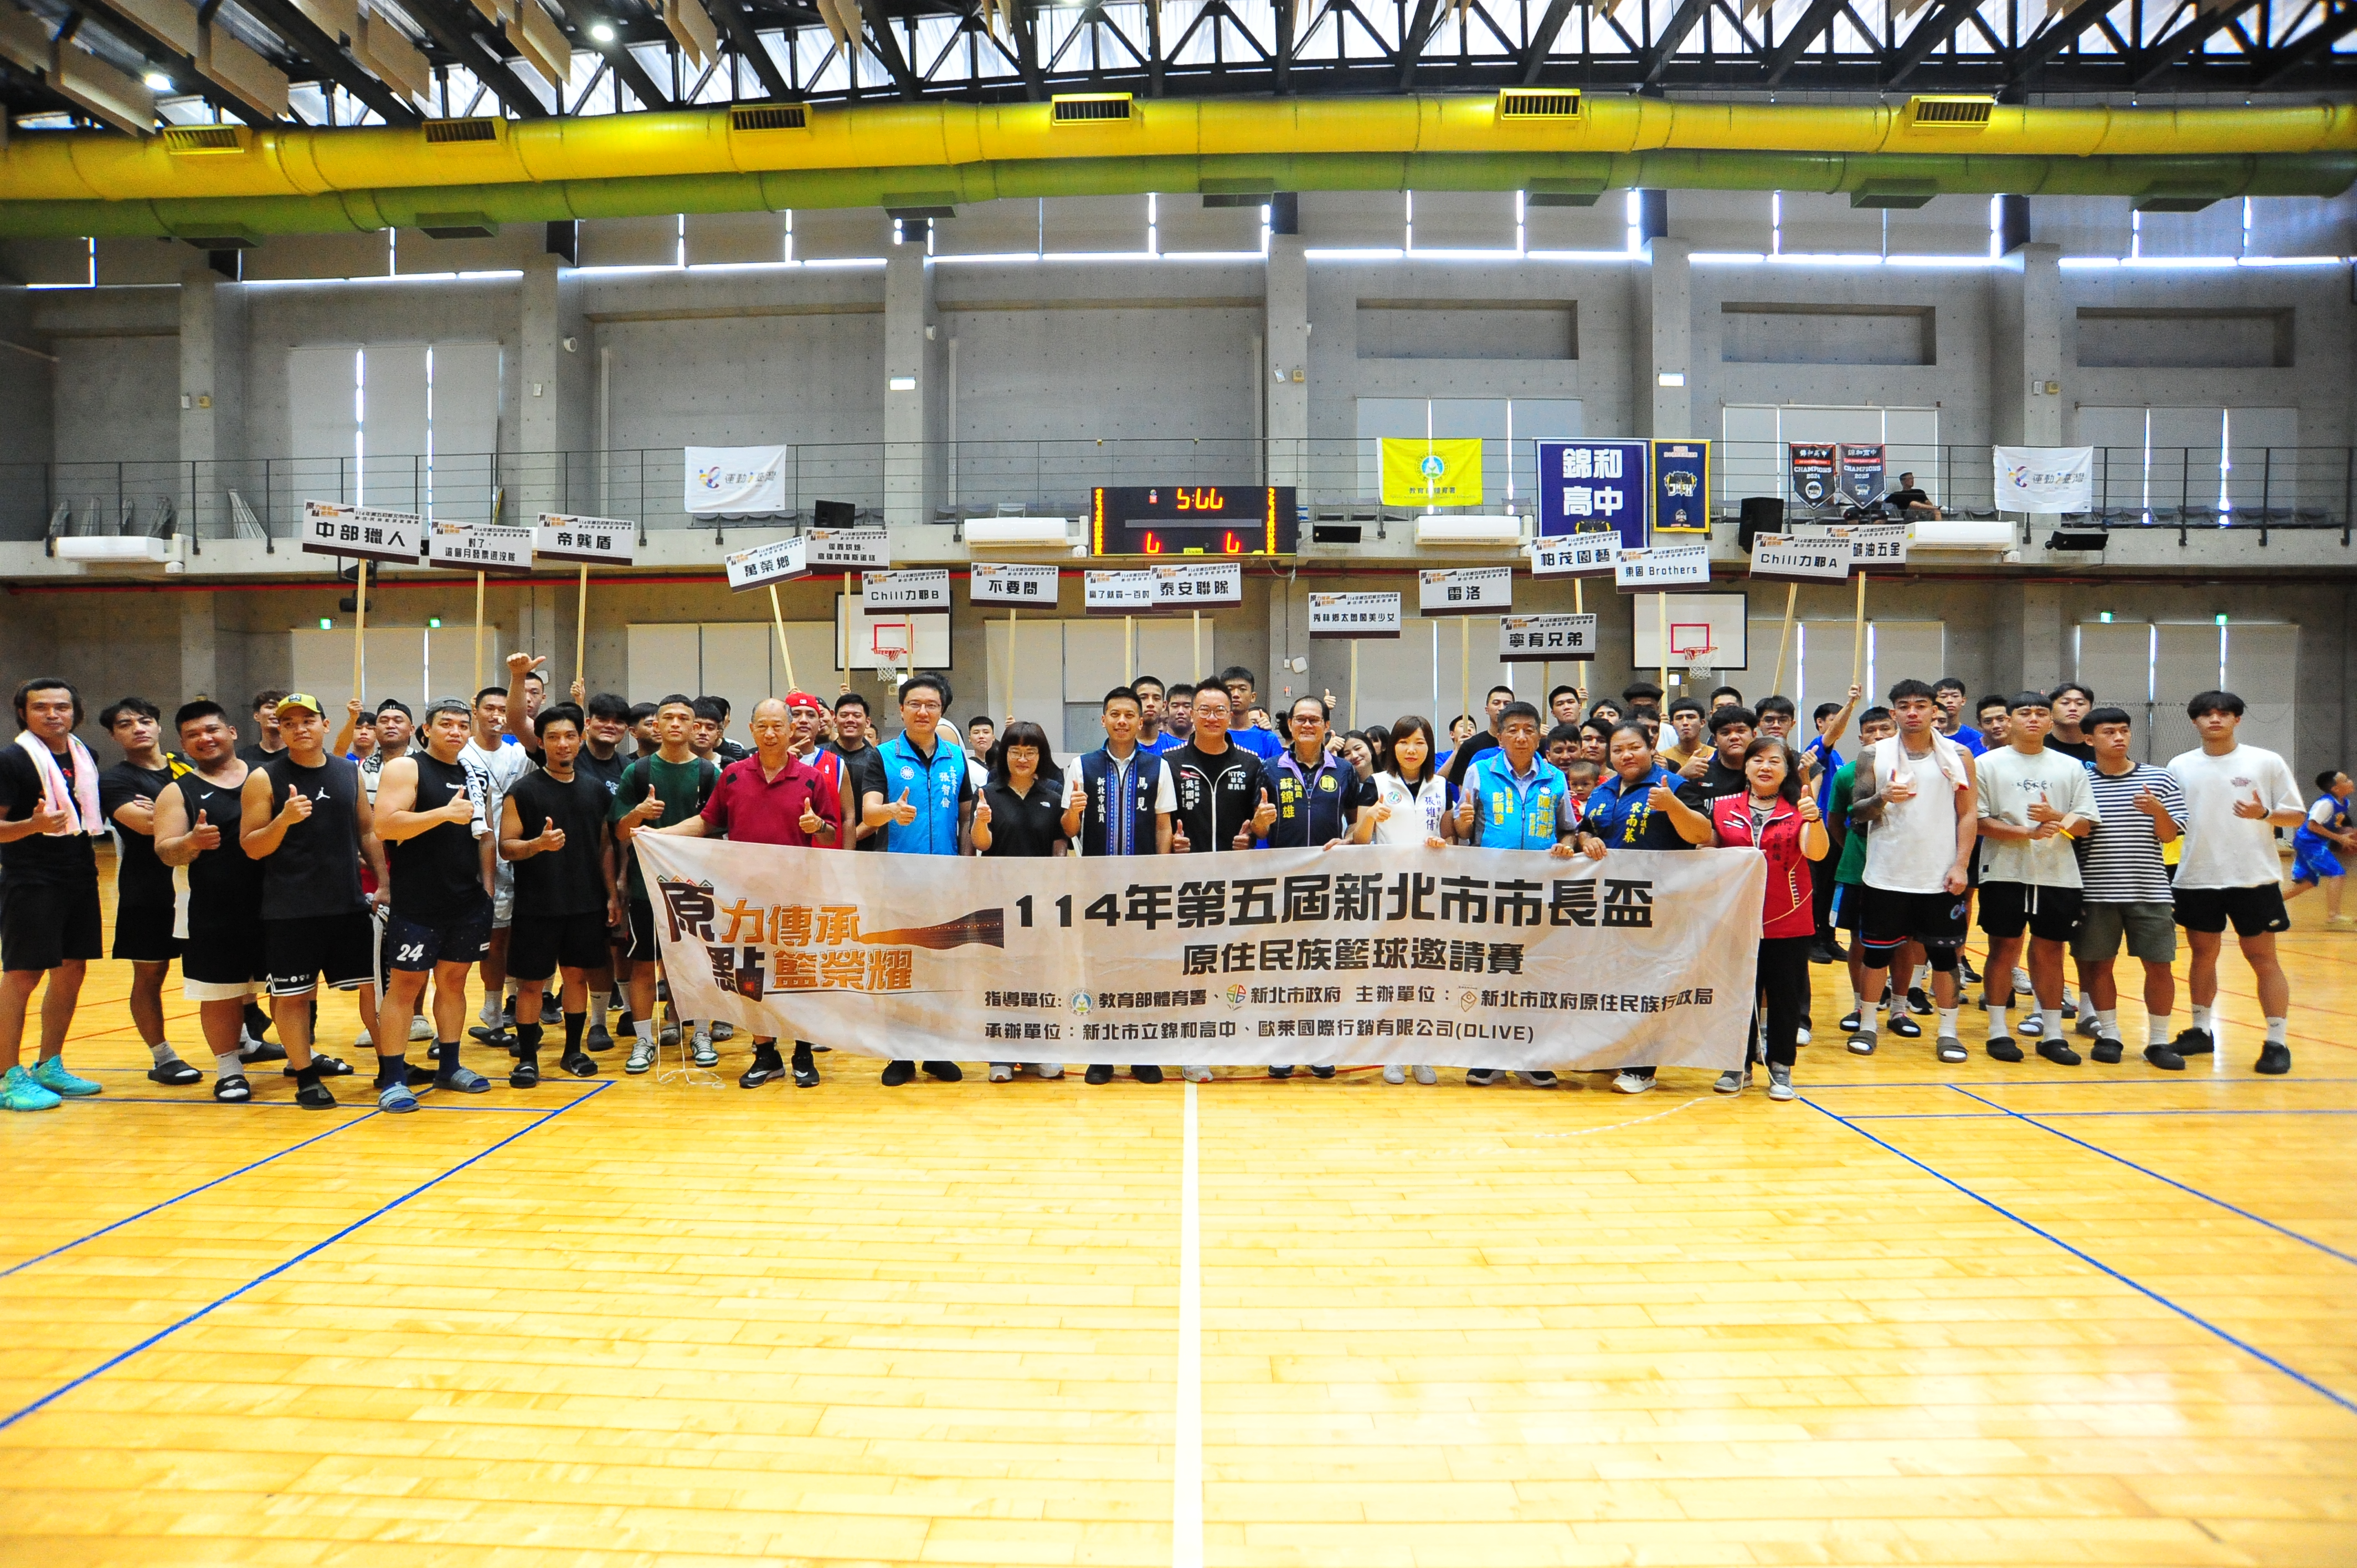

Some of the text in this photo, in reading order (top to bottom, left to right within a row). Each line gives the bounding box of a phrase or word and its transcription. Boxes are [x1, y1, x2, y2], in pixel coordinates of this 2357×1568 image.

[1563, 448, 1623, 479] 錦和
[1563, 486, 1623, 516] 高中
[316, 522, 405, 547] 中部獵人
[744, 555, 790, 577] 萬榮鄉
[1541, 549, 1610, 566] 柏茂園藝
[1649, 566, 1697, 576] Brothers
[989, 580, 1038, 595] 不要問
[1160, 580, 1229, 596] 泰安聯隊
[1448, 586, 1480, 601] 雷洛
[1314, 613, 1394, 622] 秀林鄉太魯閣美少女
[939, 772, 951, 808] 張智倫
[1097, 777, 1106, 823] 新北市議員
[1136, 777, 1148, 811] 馬見
[1280, 777, 1295, 818] 蘇錦雄
[1640, 802, 1651, 835] 北市議員
[1016, 872, 1653, 930] 114年第五屆新北市市長盃
[397, 944, 424, 961] 24
[1182, 938, 1525, 976] 原住民族籃球邀請賽
[1250, 986, 1341, 1004] 新北市政府
[1481, 988, 1713, 1013] 新北市政府原住民族行政局
